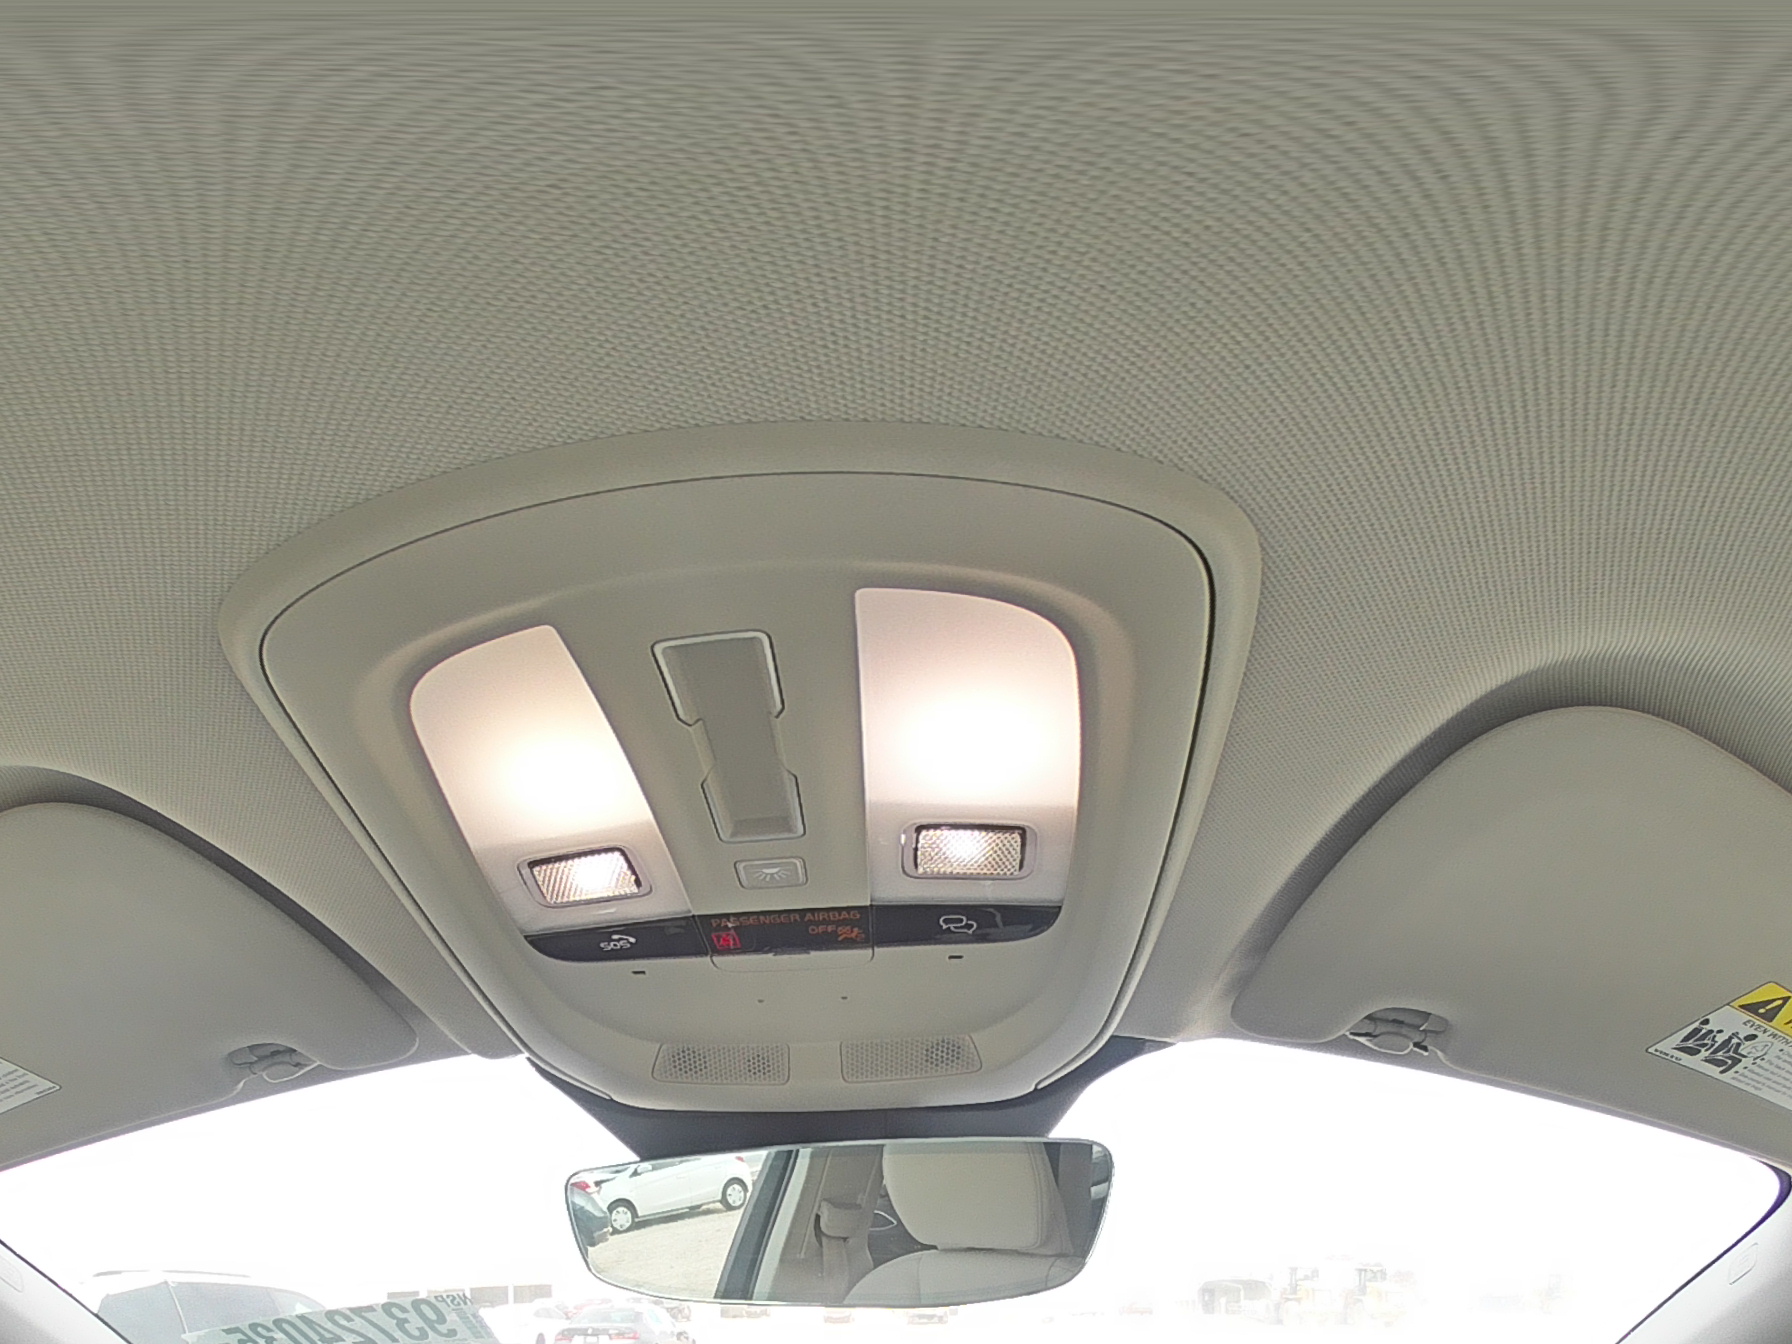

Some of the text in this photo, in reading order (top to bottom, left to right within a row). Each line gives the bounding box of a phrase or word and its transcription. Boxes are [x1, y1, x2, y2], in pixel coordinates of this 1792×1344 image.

[711, 911, 860, 928] PASSENGER AIRBAG
[809, 925, 836, 934] OFF
[599, 940, 631, 951] SOS
[1743, 1019, 1768, 1034] EVEN
[1768, 1031, 1789, 1045] WITH
